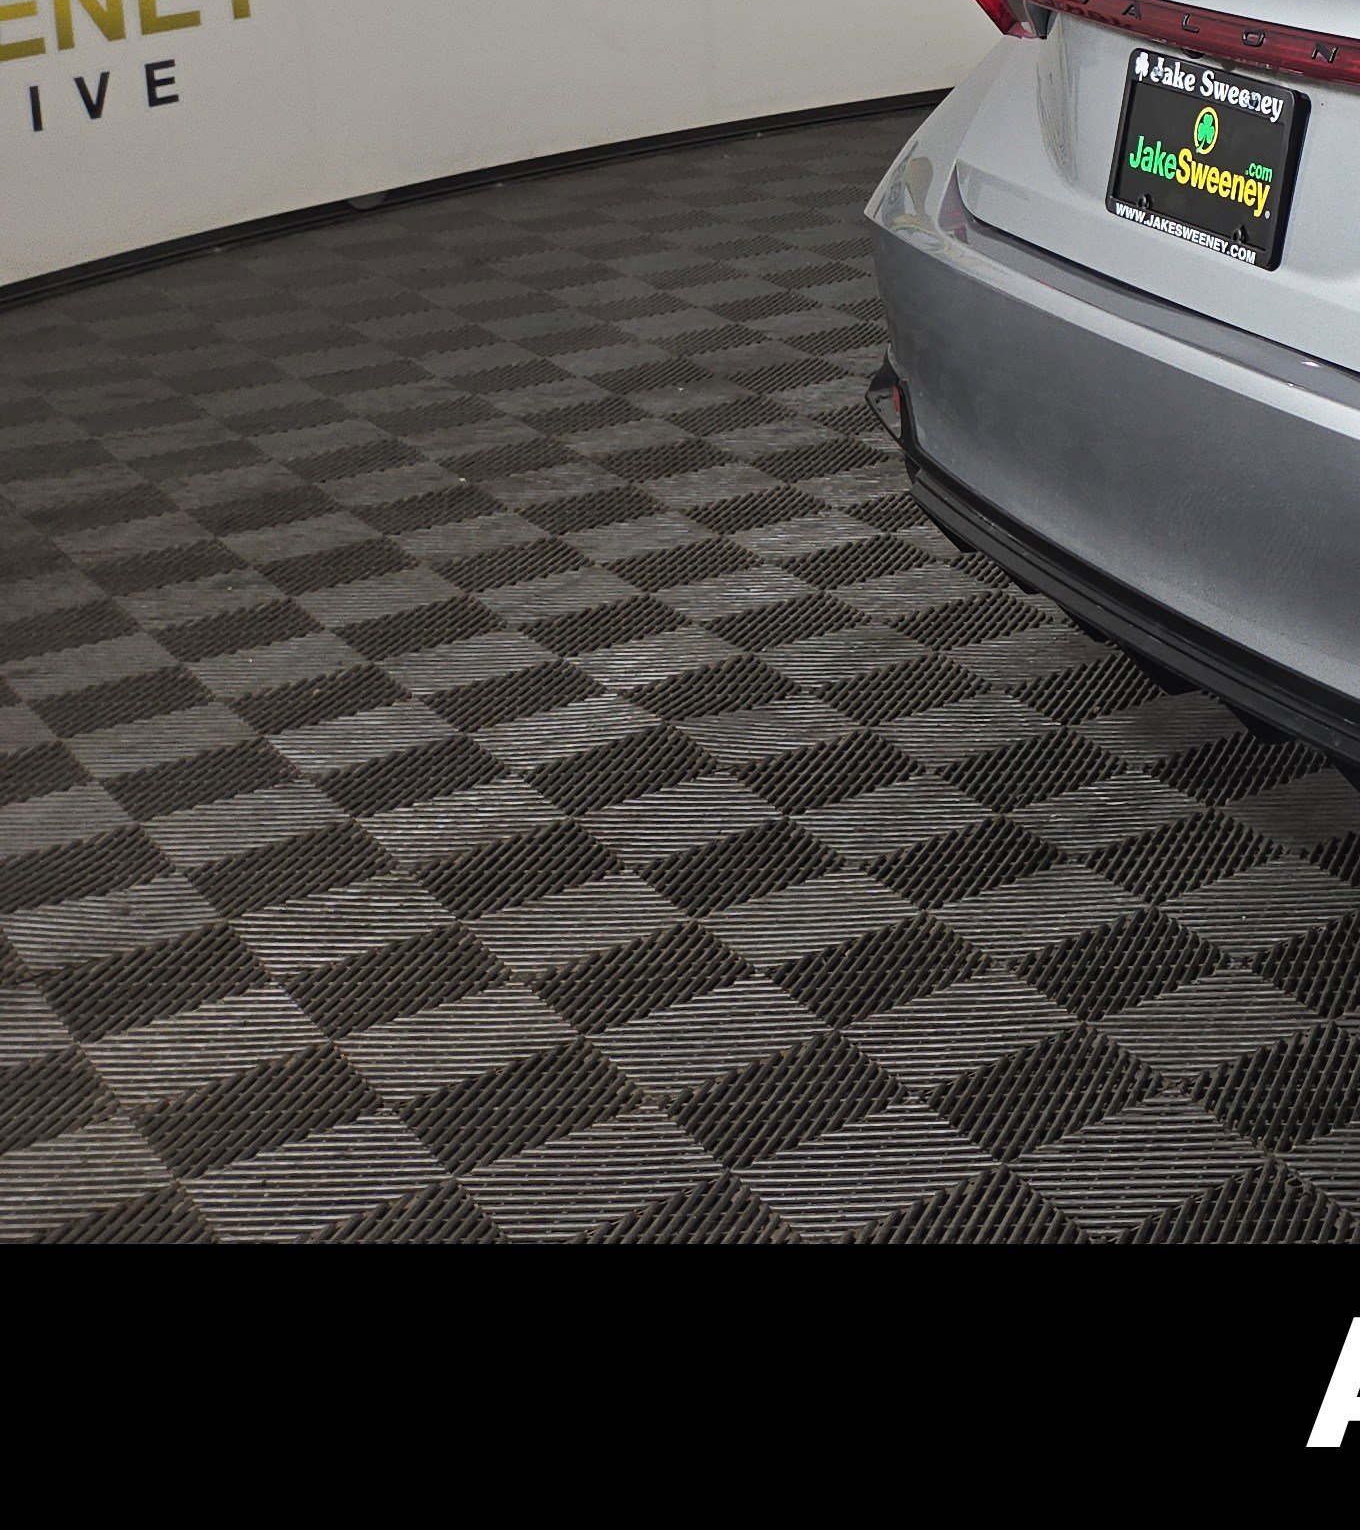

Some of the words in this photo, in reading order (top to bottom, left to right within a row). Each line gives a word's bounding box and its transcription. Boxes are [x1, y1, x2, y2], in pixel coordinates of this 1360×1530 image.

[28, 58, 180, 133] IVE
[1150, 57, 1196, 92] Jake
[1200, 70, 1284, 123] Sweeney
[1245, 162, 1273, 182] .com
[1115, 202, 1257, 264] WWW.JAKESWEENEY.COM
